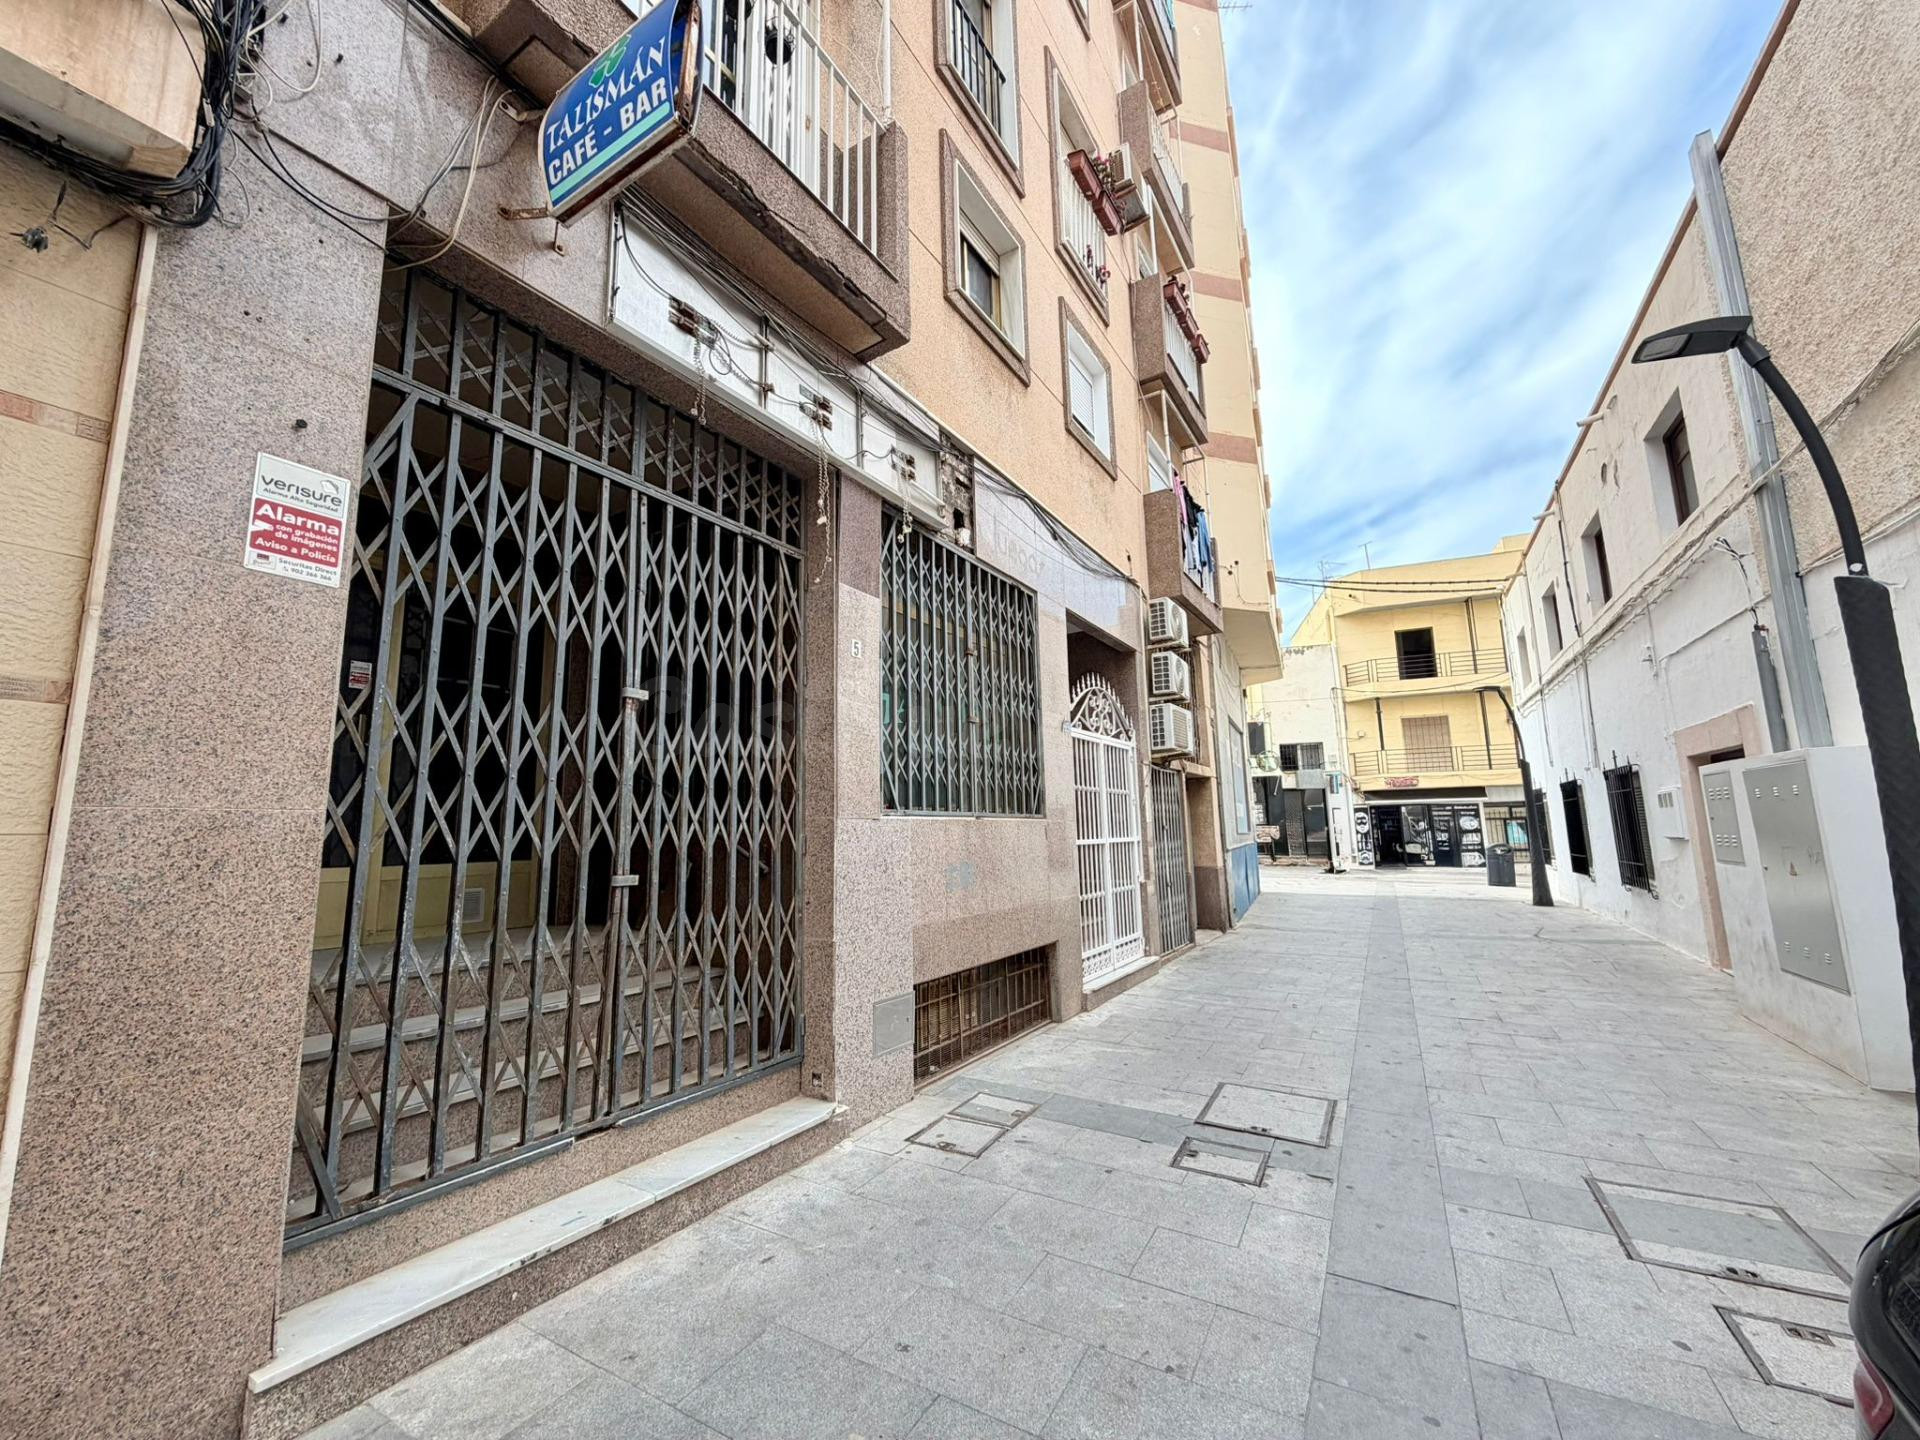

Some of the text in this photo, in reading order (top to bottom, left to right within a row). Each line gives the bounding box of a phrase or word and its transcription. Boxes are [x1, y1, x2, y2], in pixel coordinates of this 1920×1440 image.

[546, 35, 666, 153] TALISMÁN
[548, 125, 598, 186] CAFÉ
[619, 77, 668, 132] BAR
[305, 499, 339, 513] Seguridad
[256, 503, 339, 536] Alarma
[274, 531, 338, 552] de imágenes
[275, 524, 339, 545] con grabación
[255, 537, 288, 551] Aviso
[300, 547, 337, 563] Policía
